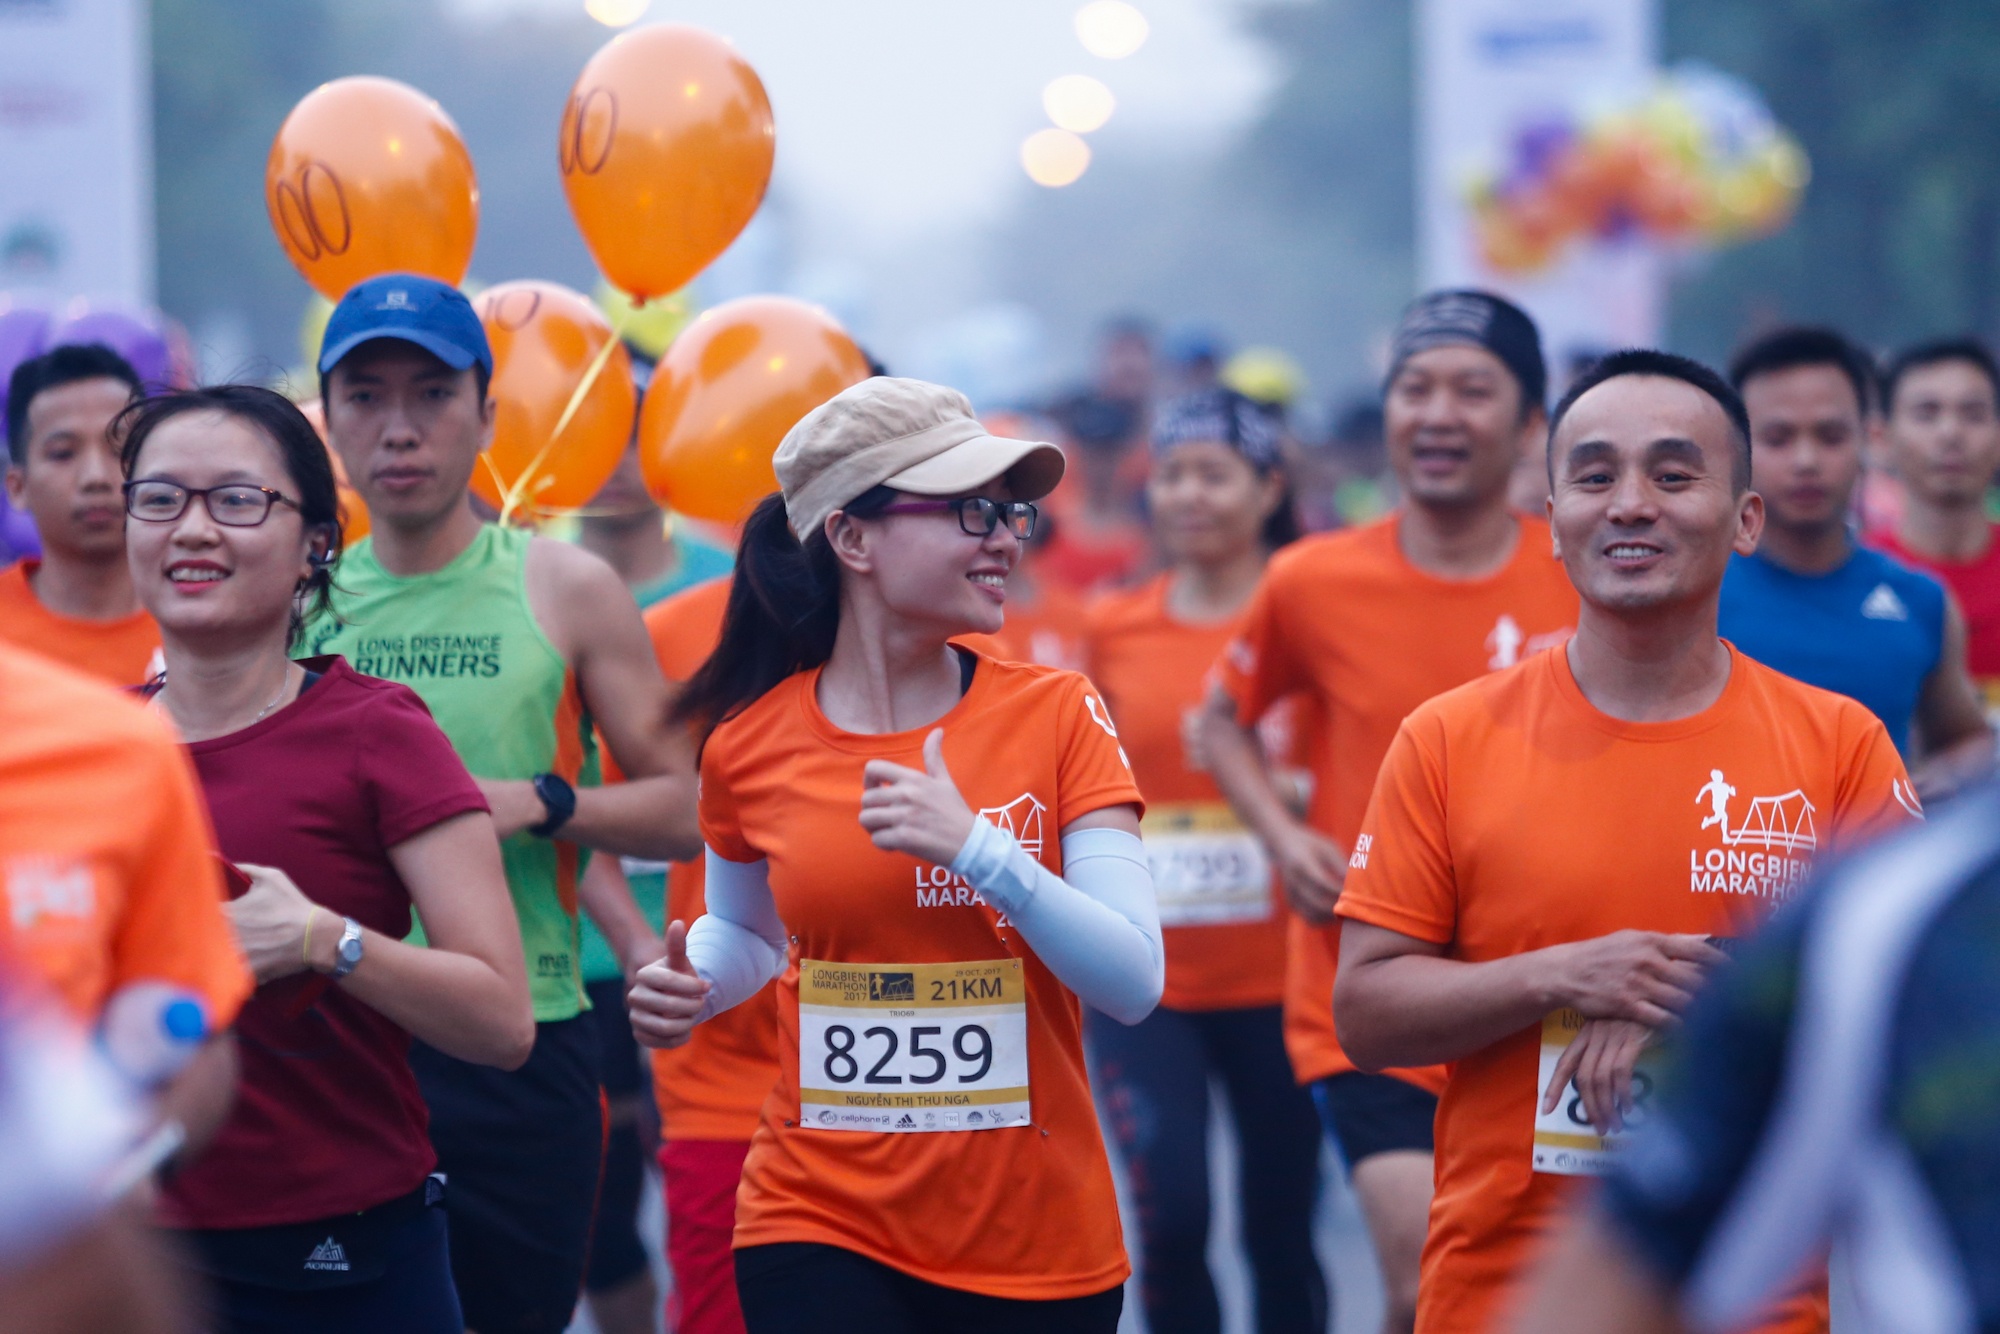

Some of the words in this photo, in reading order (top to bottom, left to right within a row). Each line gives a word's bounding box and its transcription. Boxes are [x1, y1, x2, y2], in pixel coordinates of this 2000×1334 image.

[357, 637, 404, 652] LONG
[410, 635, 500, 650] DISTANCE
[356, 653, 500, 678] RUNNERS
[1691, 849, 1812, 883] LONGBIEN
[1691, 872, 1801, 900] MARATHO
[917, 887, 986, 908] MARA
[813, 969, 867, 983] LONGBIEN
[984, 967, 1001, 975] 2017
[813, 980, 867, 992] MARATHON
[931, 977, 1002, 1000] 21KM
[844, 991, 867, 1001] 2017
[824, 1024, 993, 1085] 8259
[846, 1093, 892, 1106] NGUYỄN
[894, 1096, 914, 1108] THỊ
[917, 1096, 941, 1106] THU
[944, 1095, 970, 1105] NGA
